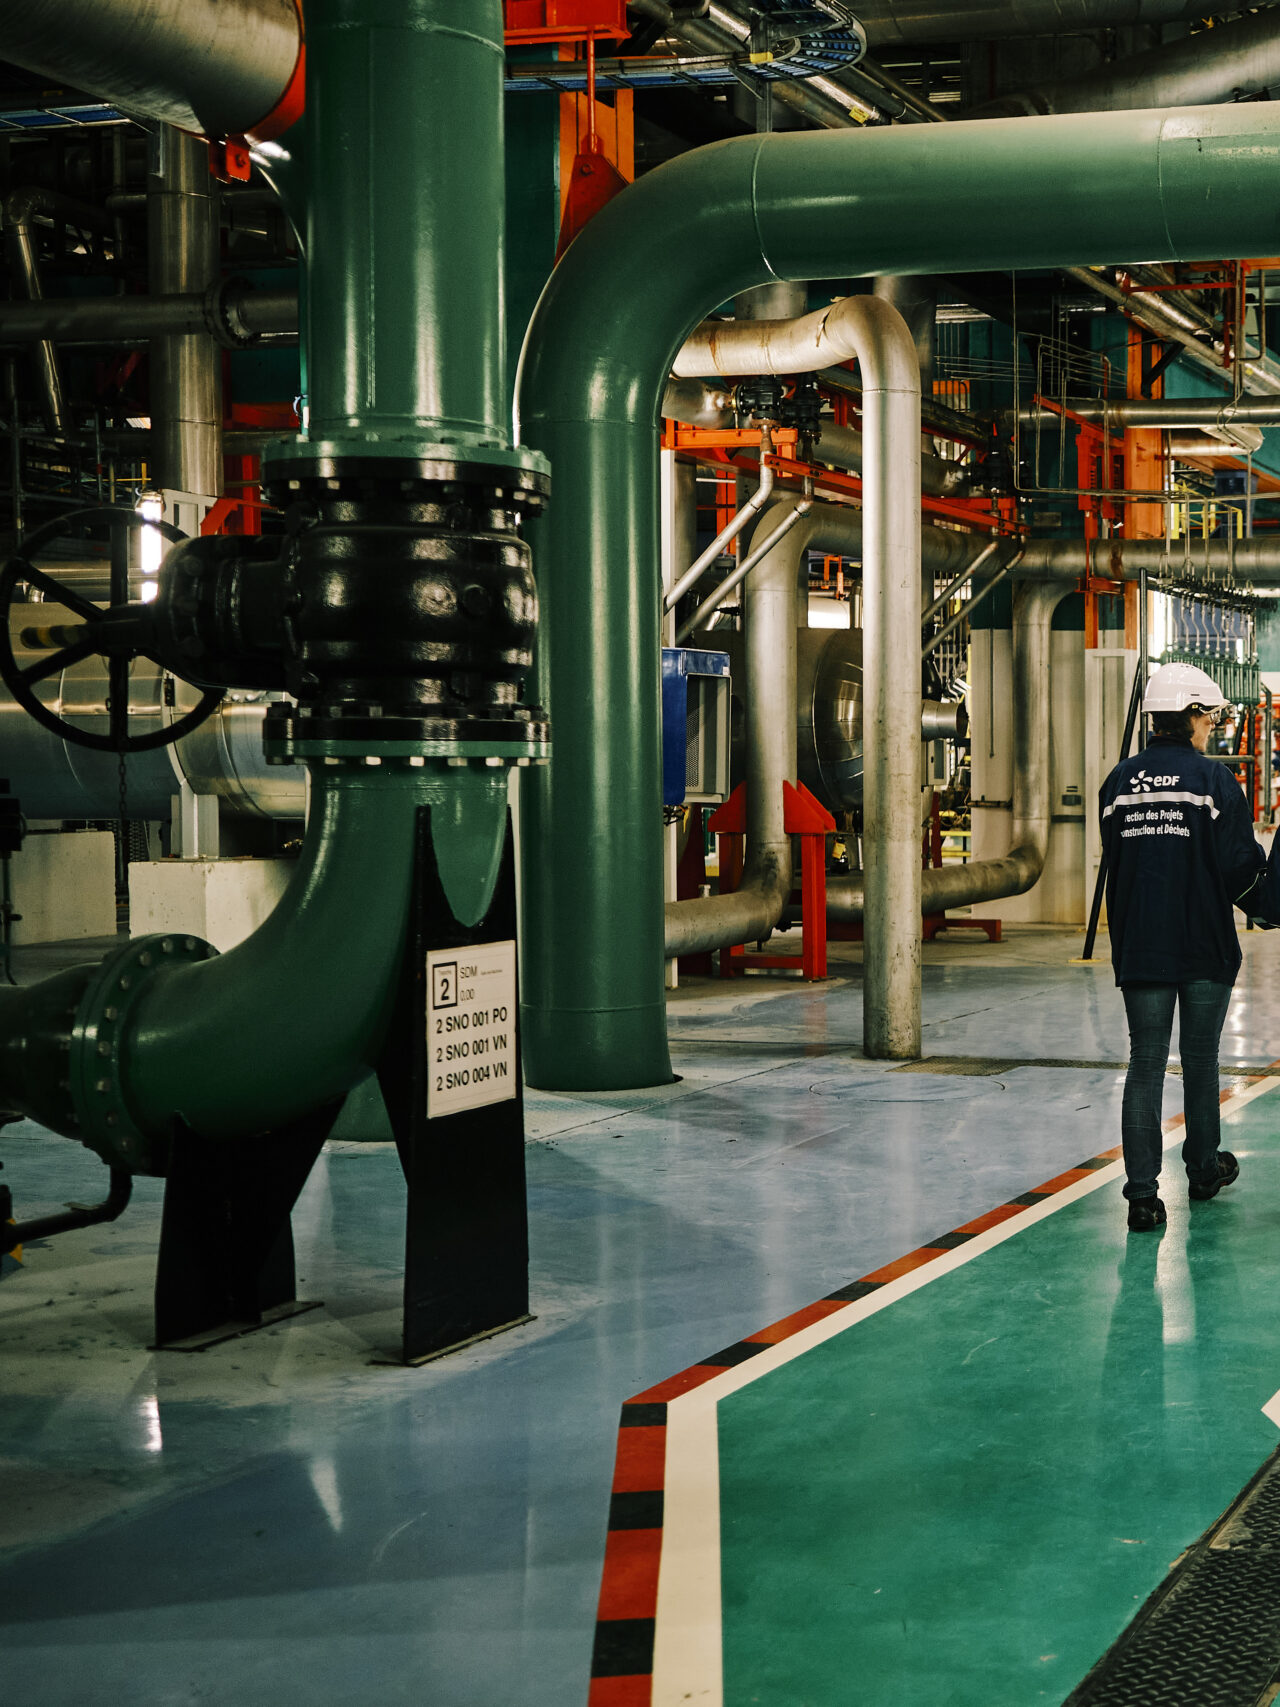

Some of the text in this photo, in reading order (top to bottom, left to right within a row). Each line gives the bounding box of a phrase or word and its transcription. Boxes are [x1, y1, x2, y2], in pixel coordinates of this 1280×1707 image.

[1146, 810, 1159, 820] des
[1160, 809, 1184, 822] Projets
[1156, 825, 1164, 835] et
[1164, 823, 1191, 837] Déchets
[460, 965, 478, 979] SDM
[440, 977, 450, 1001] 2
[436, 1006, 508, 1034] 2 SNO 001 PO
[436, 1034, 507, 1063] 2 SNO 001 VN
[436, 1061, 508, 1092] 2 SNO 004 VN
